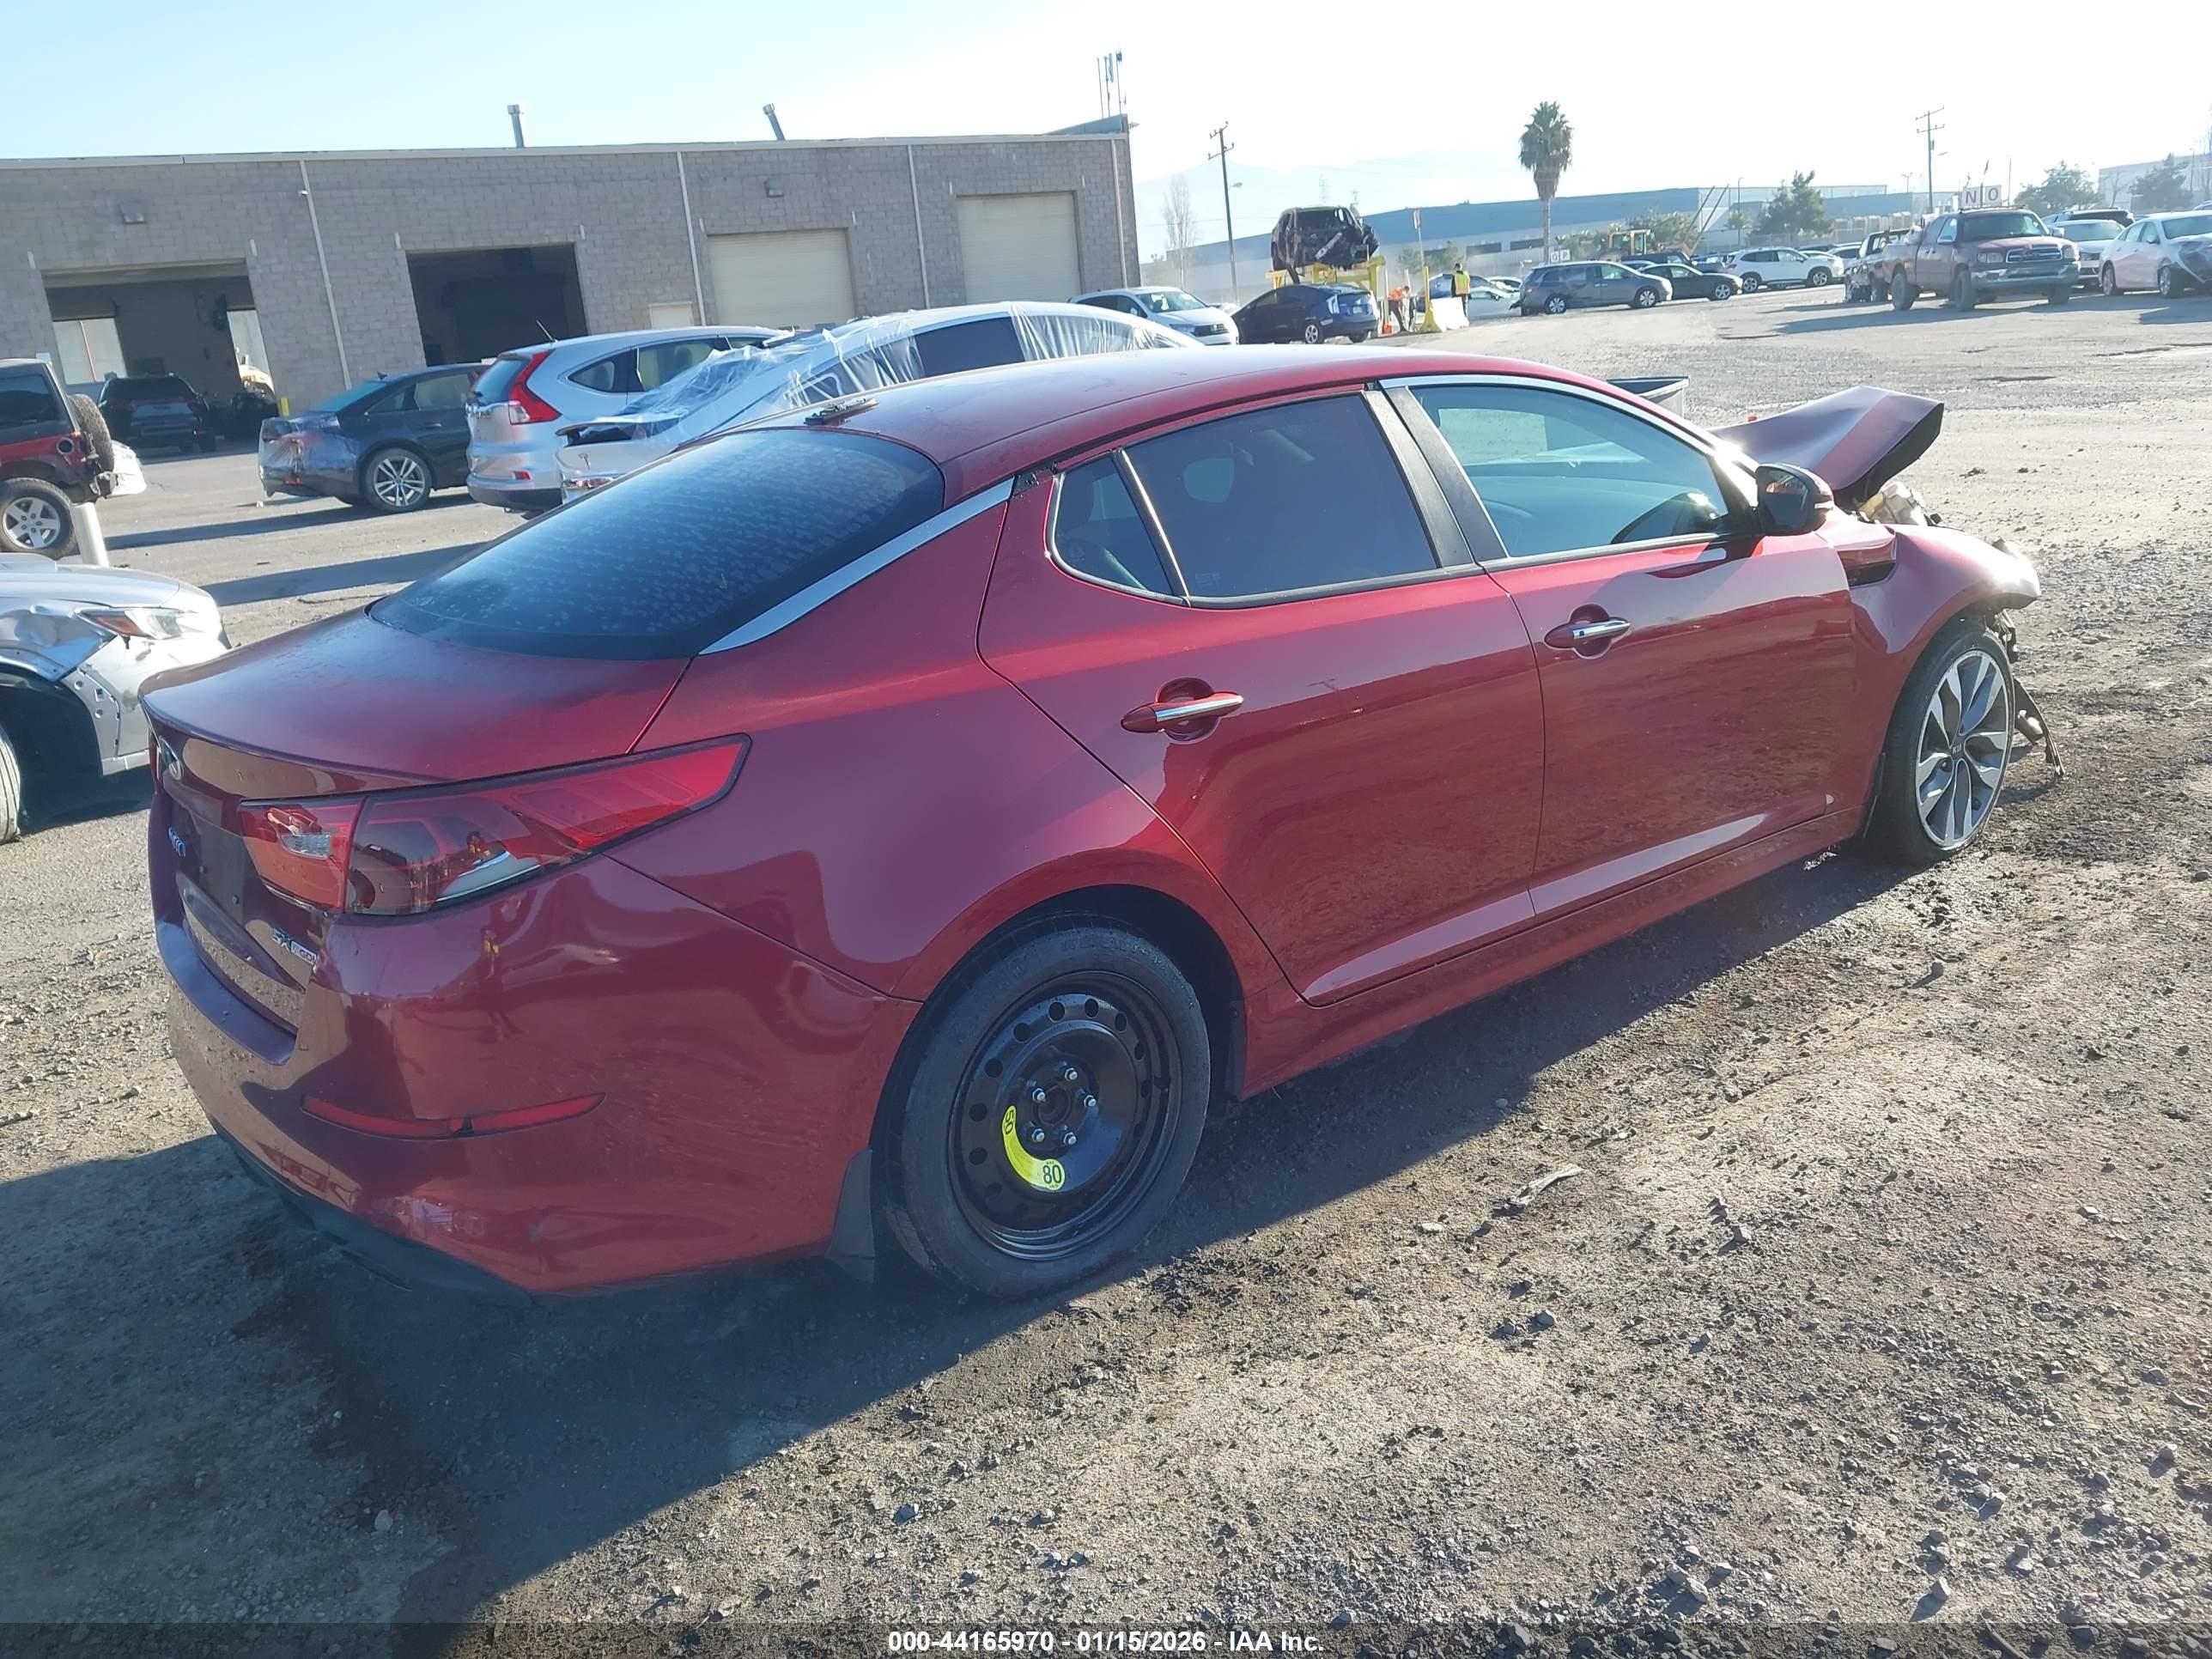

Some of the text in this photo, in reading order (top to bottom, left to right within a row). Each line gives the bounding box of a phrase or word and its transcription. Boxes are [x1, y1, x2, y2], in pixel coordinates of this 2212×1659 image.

[1966, 187, 1999, 204] N O
[1005, 1109, 1014, 1135] 50
[1042, 1164, 1062, 1184] 80
